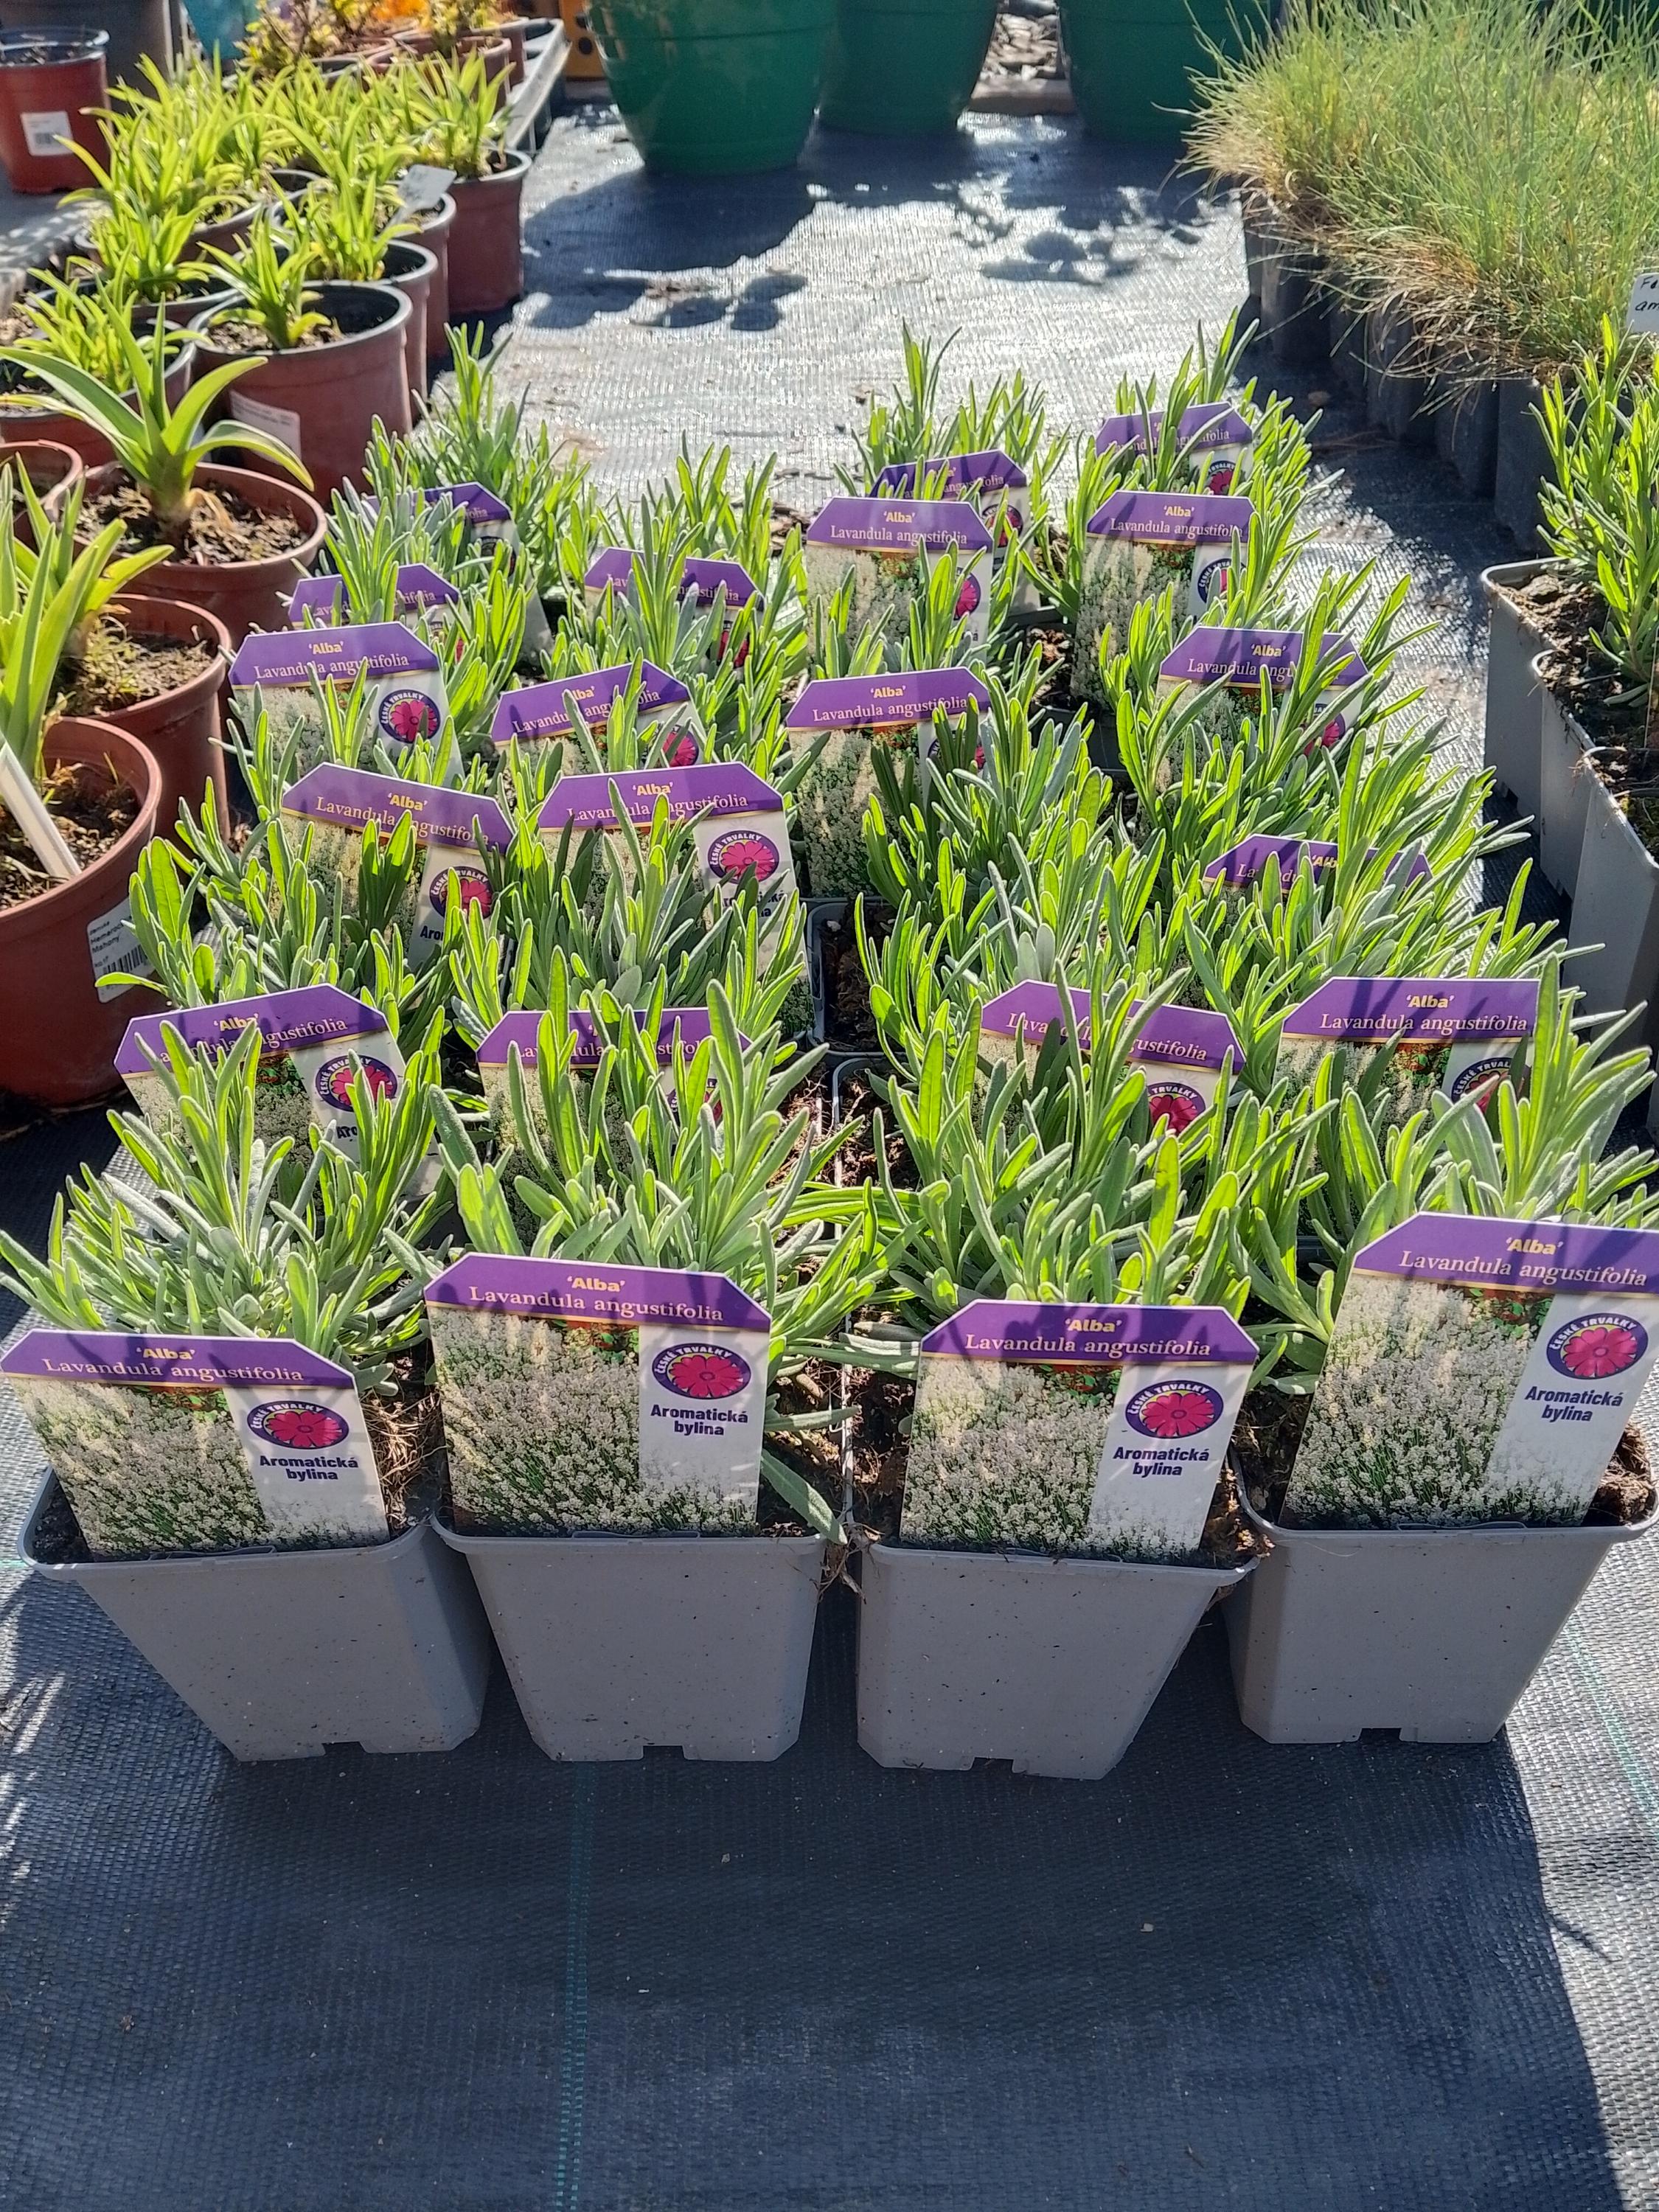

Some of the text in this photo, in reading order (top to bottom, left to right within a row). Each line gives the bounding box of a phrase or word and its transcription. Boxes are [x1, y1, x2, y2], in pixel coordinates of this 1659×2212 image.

[830, 525, 892, 541] Lavandula
[1110, 518, 1243, 540] Lavandula angustifol
[1187, 658, 1256, 675] Lavandula
[813, 704, 883, 722] Lavandula
[316, 796, 395, 826] Lavandula
[566, 801, 650, 822] Lavanula
[722, 833, 762, 845] TRVALKY
[1320, 1013, 1528, 1036] Lavandula angustifolia
[1152, 1085, 1198, 1099] TRVALKY
[1399, 1251, 1647, 1287] Lavandula angustifolia
[469, 1286, 724, 1322] Lavandula angustifolia
[1549, 1317, 1637, 1351] ČESKÉ TRVALKY
[964, 1334, 1211, 1359] Lavandula angustifolia
[42, 1358, 304, 1382] Lavandula angustifolia
[654, 1346, 734, 1374] ČESKÉ TRVALKY
[1127, 1384, 1211, 1415] ČESKÉ TRVALKY
[1525, 1385, 1624, 1407] Aromatická
[250, 1402, 325, 1429] ČESKÉ TRVALKY
[650, 1404, 748, 1424] Aromatická
[1542, 1405, 1593, 1422] bylina
[674, 1420, 725, 1436] bylina
[260, 1454, 358, 1469] Aromatická
[1113, 1446, 1210, 1461] Aromatická
[286, 1468, 338, 1481] bylina
[1132, 1461, 1183, 1478] bylina
